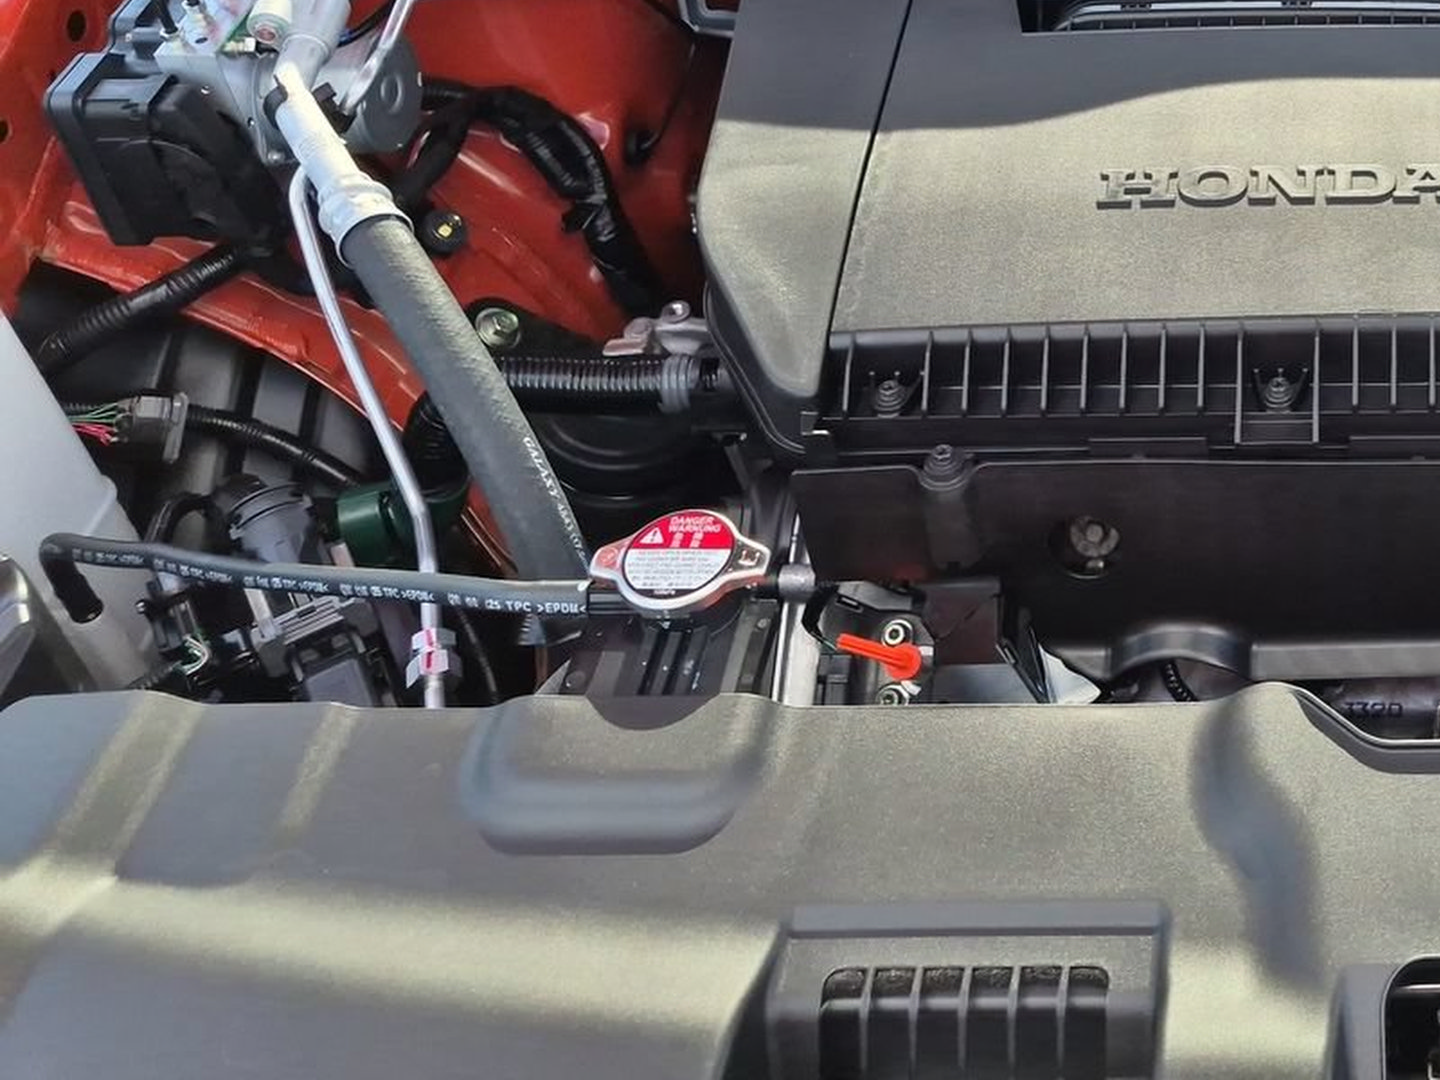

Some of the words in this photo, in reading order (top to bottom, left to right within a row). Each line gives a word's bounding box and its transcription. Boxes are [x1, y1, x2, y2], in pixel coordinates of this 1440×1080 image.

[523, 436, 560, 499] GALAXY
[670, 515, 715, 525] DANGER
[505, 601, 532, 612] TPC
